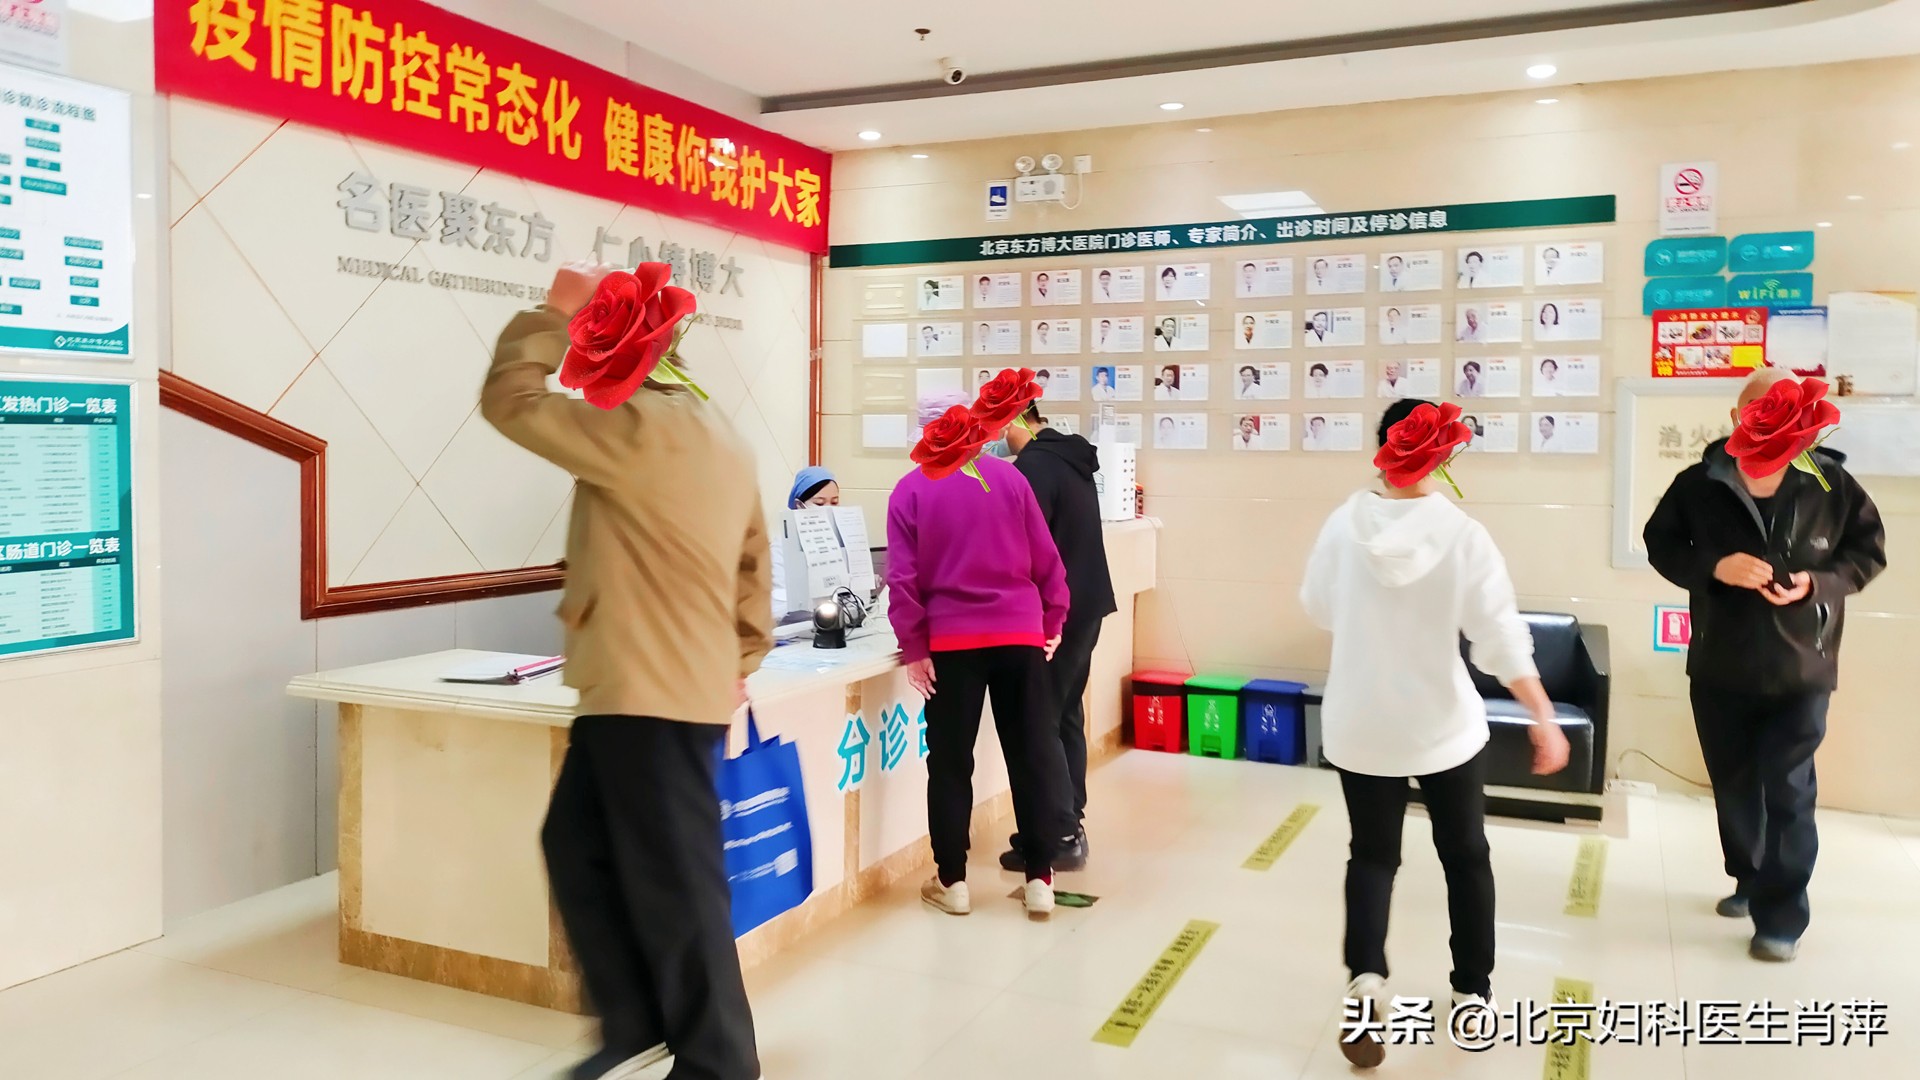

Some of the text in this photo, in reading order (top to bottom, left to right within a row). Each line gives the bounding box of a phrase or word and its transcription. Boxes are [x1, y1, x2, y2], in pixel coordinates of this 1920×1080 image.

[189, 0, 583, 160] 疫情防控常态化
[603, 97, 822, 228] 健康你我护大家
[336, 171, 556, 262] 名医聚东方
[979, 209, 1449, 256] 北京东方博大医院门诊医师、专家简介、出诊时间及停诊信息
[337, 256, 424, 284] MEDICAL
[427, 270, 526, 300] GATHERING
